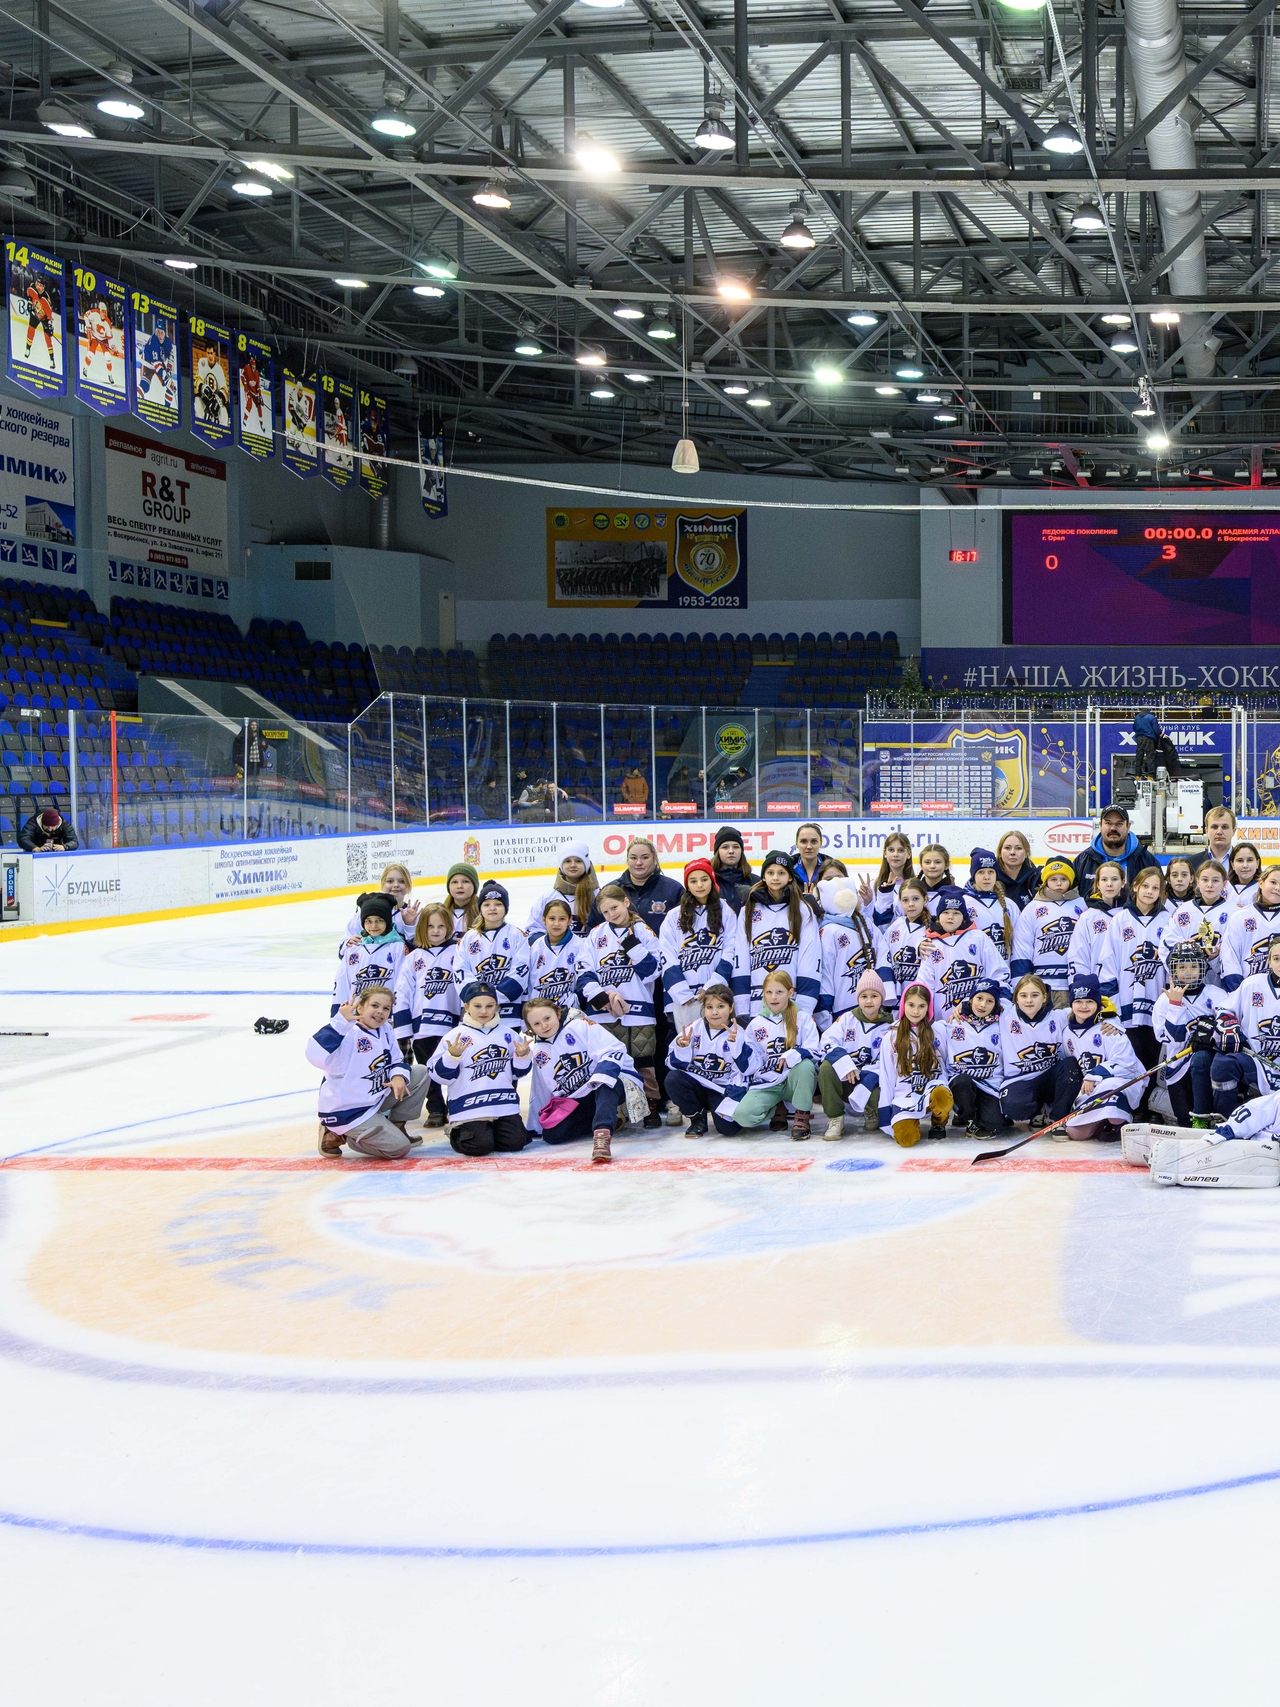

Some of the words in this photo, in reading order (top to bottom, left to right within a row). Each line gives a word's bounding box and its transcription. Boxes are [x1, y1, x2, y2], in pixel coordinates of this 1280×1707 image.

[6, 242, 29, 267] 14
[31, 252, 62, 270] ЛОМАКИН
[74, 268, 96, 291] 10
[106, 280, 125, 294] ТИТОВ
[132, 292, 150, 314] 13
[189, 316, 206, 337] 18
[237, 334, 247, 352] 8
[322, 375, 334, 393] 13
[360, 390, 370, 407] 16
[6, 406, 59, 431] хоккейная
[31, 428, 70, 448] резерва
[109, 437, 143, 454] рекламное
[150, 453, 178, 468] agrit.ru
[142, 470, 190, 506] R&T
[142, 499, 191, 524] GROUP
[107, 515, 128, 526] ВЕСЬ
[128, 519, 158, 533] СПЕКТР
[158, 526, 202, 544] РЕКЛАМНЫХ
[202, 535, 223, 548] УСЛУГ
[684, 524, 733, 533] ХИМИК
[1144, 528, 1212, 540] 00:00.0
[700, 552, 716, 566] 70
[953, 551, 976, 562] 16:17
[1162, 545, 1176, 560] 3
[1045, 554, 1058, 570] 0
[678, 596, 740, 606] 1953-2023
[963, 664, 1072, 688] #НАША
[717, 736, 748, 744] ХИМИК
[1119, 731, 1216, 746] ХМИК
[371, 840, 392, 848] OLIMPBET
[1048, 834, 1094, 844] SINTE
[220, 848, 262, 860] Воскресенская
[264, 846, 292, 856] хоккейная
[372, 850, 397, 858] ЧЕМПИОНАТ
[398, 849, 414, 857] РОССИИ
[494, 844, 557, 856] МОСКОВСКОЙ
[214, 860, 234, 869] школа
[236, 856, 276, 867] олимпийского
[277, 854, 298, 865] резерва
[494, 856, 535, 864] ОБЛАСТИ
[226, 870, 288, 886] «Химик»
[68, 880, 121, 896] БУДУЩЕЕ
[463, 1092, 517, 1108] ЗАРЯД
[1150, 1128, 1176, 1136] BAUER
